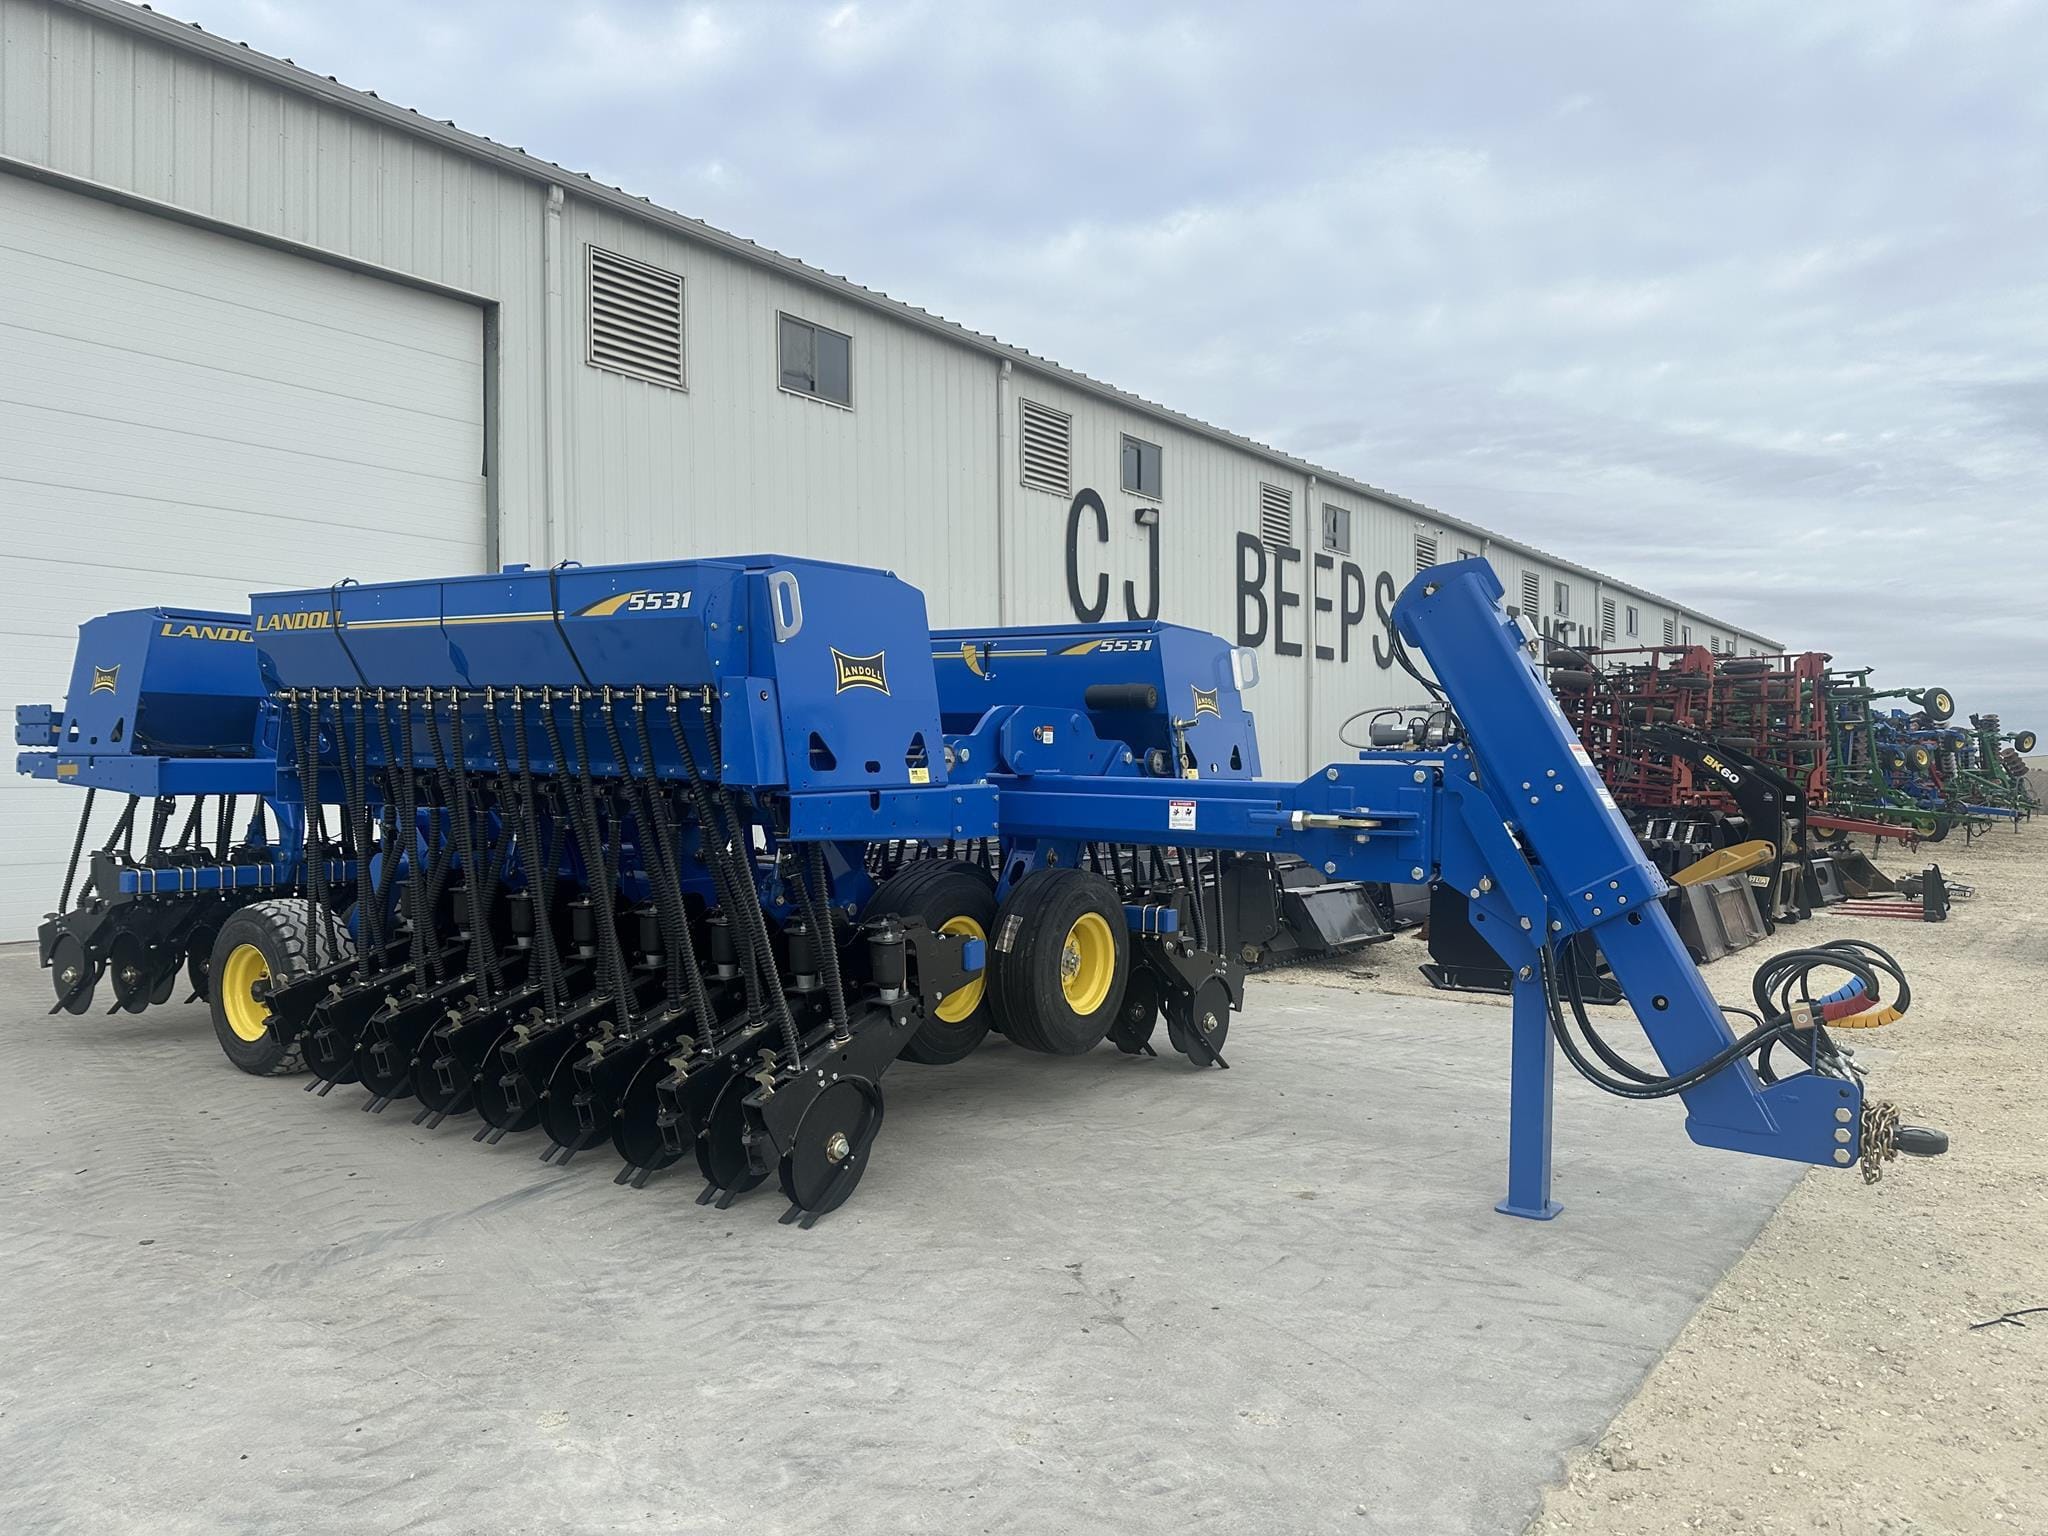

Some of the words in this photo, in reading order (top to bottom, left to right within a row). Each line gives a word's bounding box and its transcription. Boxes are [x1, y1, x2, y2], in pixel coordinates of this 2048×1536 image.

[1066, 488, 1160, 623] CJ
[628, 591, 692, 611] 5531
[256, 611, 345, 632] LANDOLL
[1099, 639, 1153, 652] 5531
[838, 657, 883, 686] LANDOLL
[1703, 754, 1740, 784] BK60
